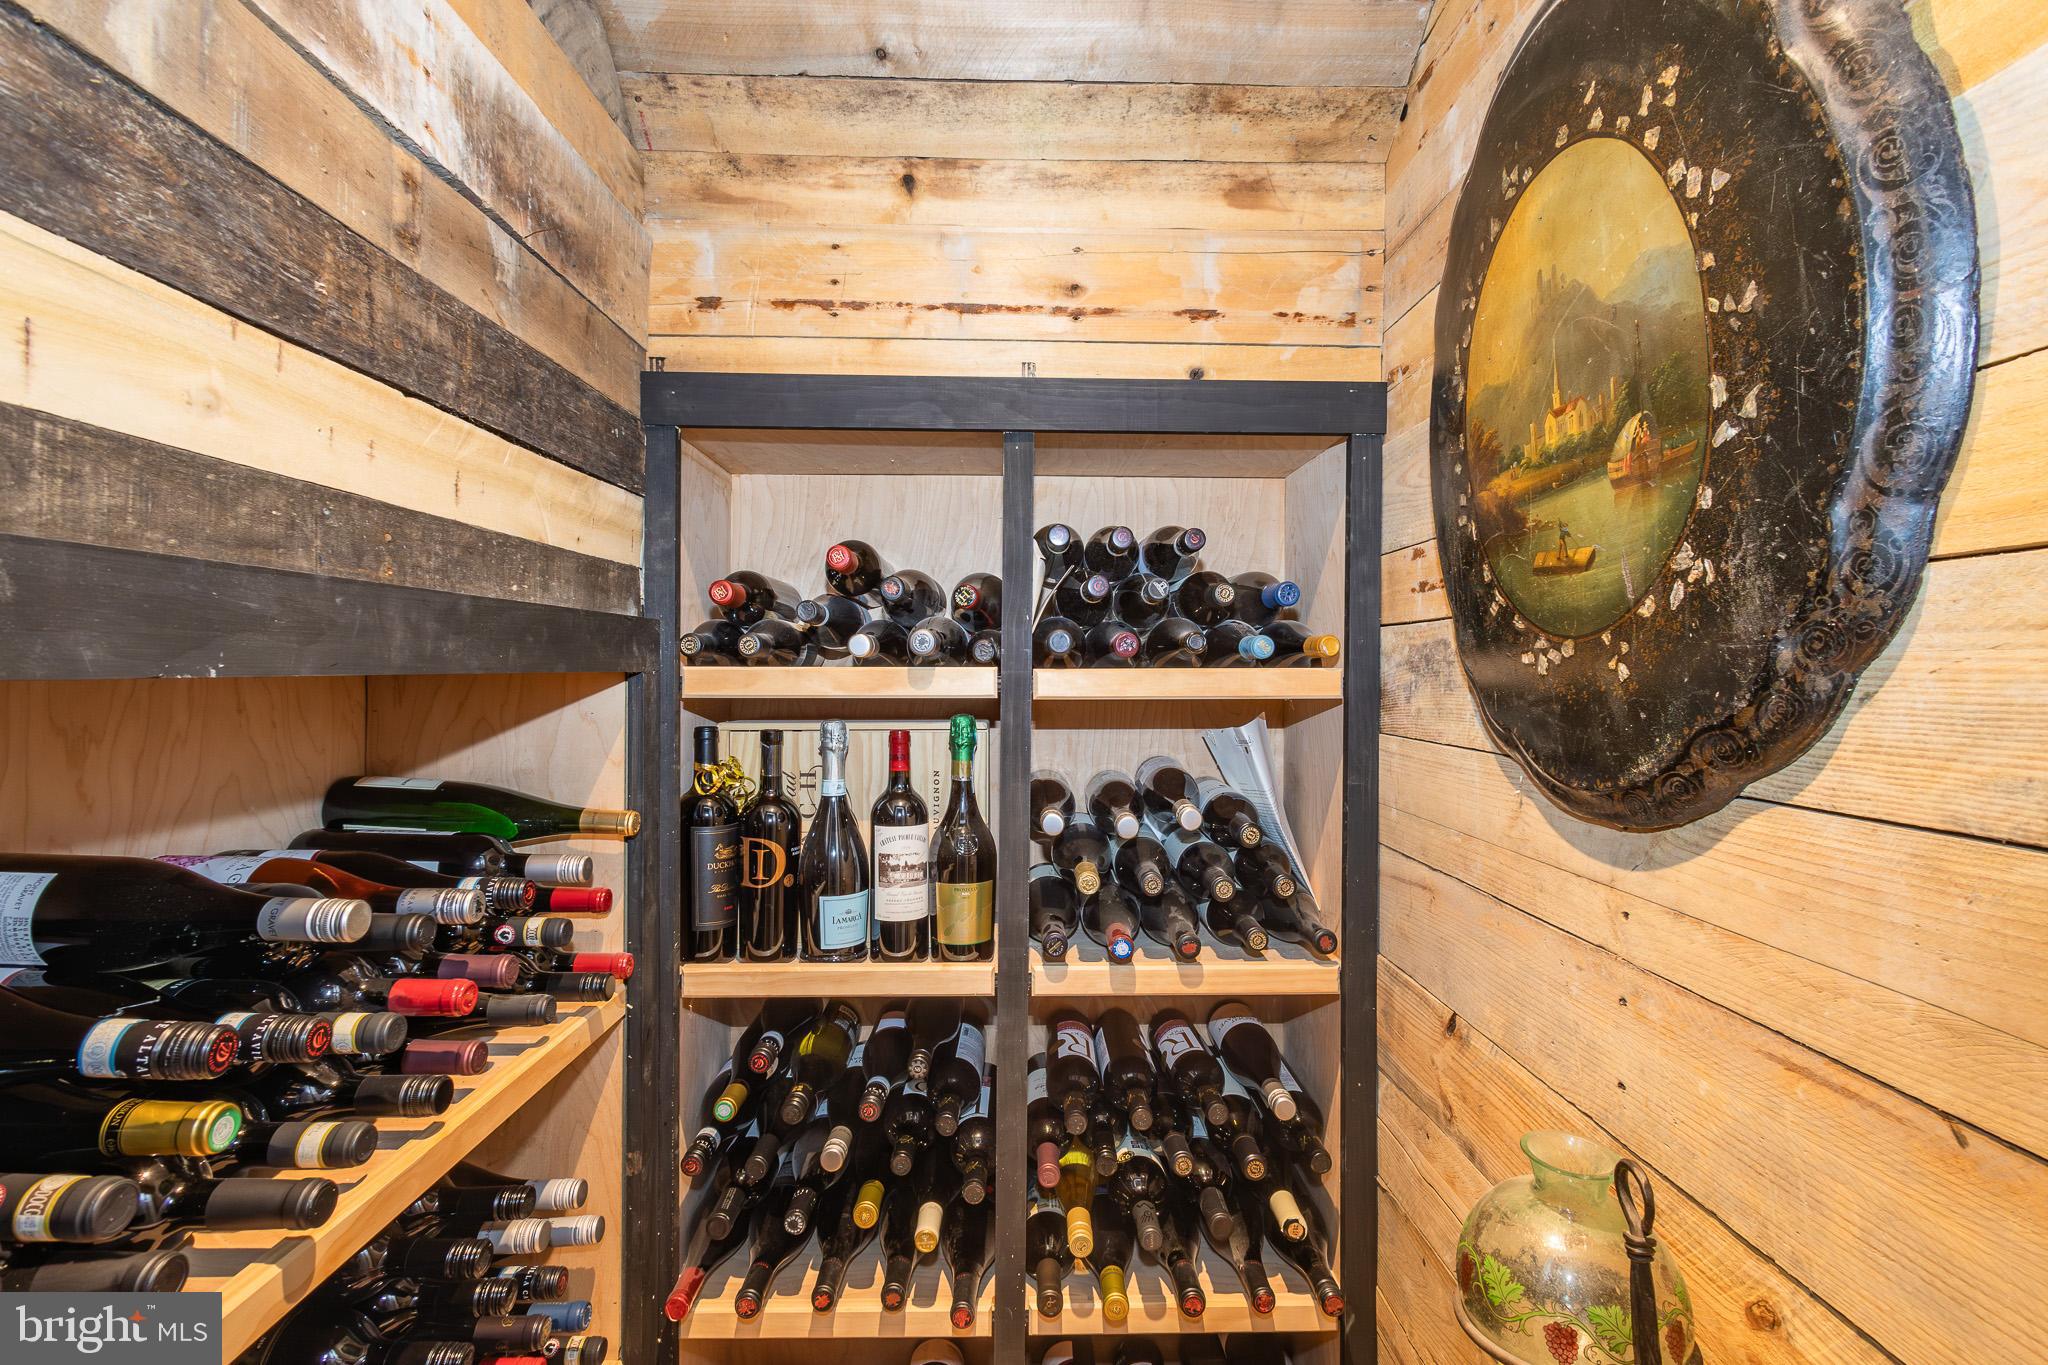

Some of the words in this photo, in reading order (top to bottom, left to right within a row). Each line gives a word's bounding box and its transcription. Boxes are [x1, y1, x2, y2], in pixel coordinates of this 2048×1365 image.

[14, 883, 33, 911] GRAVET
[28, 876, 46, 896] MONT
[251, 1014, 279, 1060] ALTAVIL
